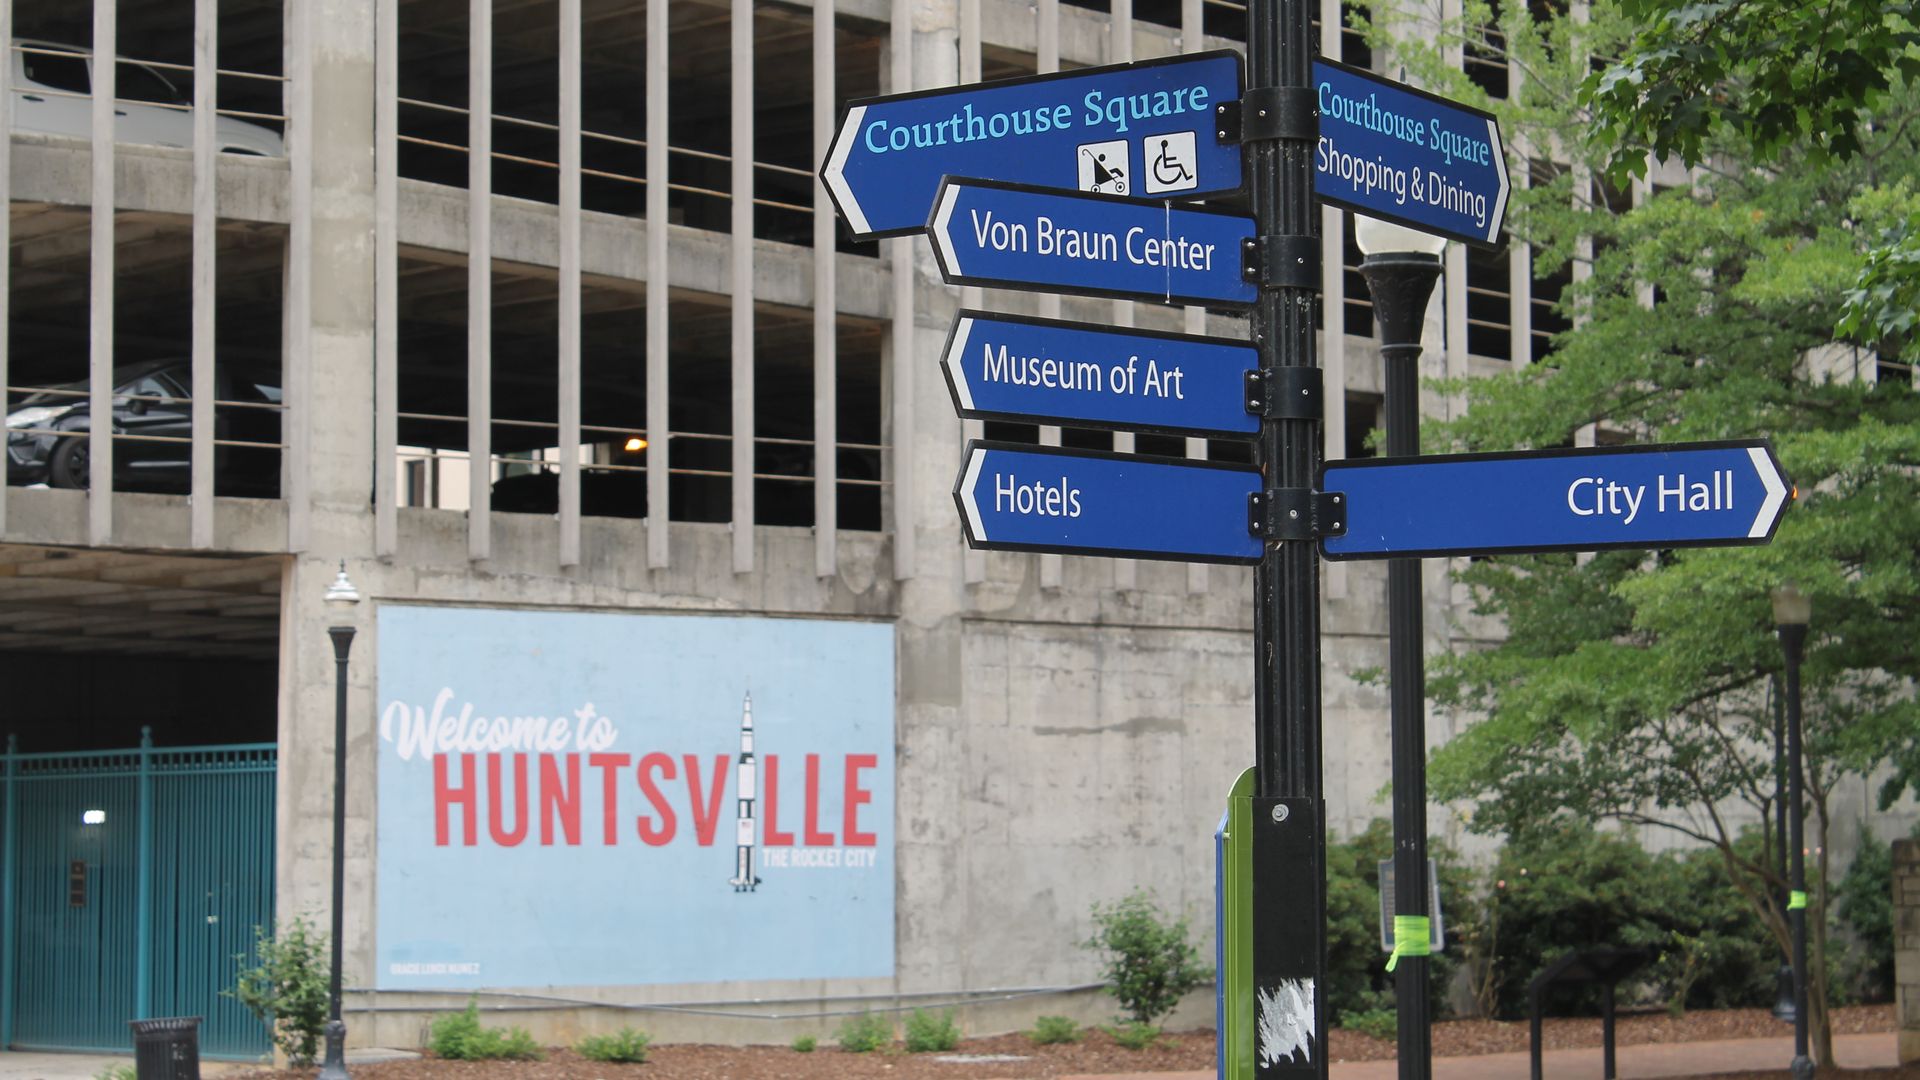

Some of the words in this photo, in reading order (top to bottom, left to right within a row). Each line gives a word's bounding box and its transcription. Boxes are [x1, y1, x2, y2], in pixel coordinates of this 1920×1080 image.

[865, 102, 1072, 154] Courthouse
[1084, 84, 1209, 133] Square
[1318, 82, 1425, 146] Courthouse
[1430, 118, 1489, 165] Square
[1318, 136, 1406, 205] Shopping
[1411, 166, 1424, 202] &
[1429, 171, 1486, 228] Dining
[971, 209, 1028, 252] Von
[1037, 216, 1118, 262] Braun
[1125, 226, 1215, 271] Center
[983, 343, 1102, 392] Museum
[1109, 355, 1138, 395] of
[1143, 359, 1184, 400] Art
[995, 473, 1081, 518] Hotels
[1567, 477, 1646, 525] City
[1658, 469, 1733, 513] Hall
[379, 687, 572, 761] Welcome
[574, 702, 619, 751] to
[762, 848, 789, 867] THE
[791, 848, 842, 867] ROCKET
[844, 848, 877, 867] CITY
